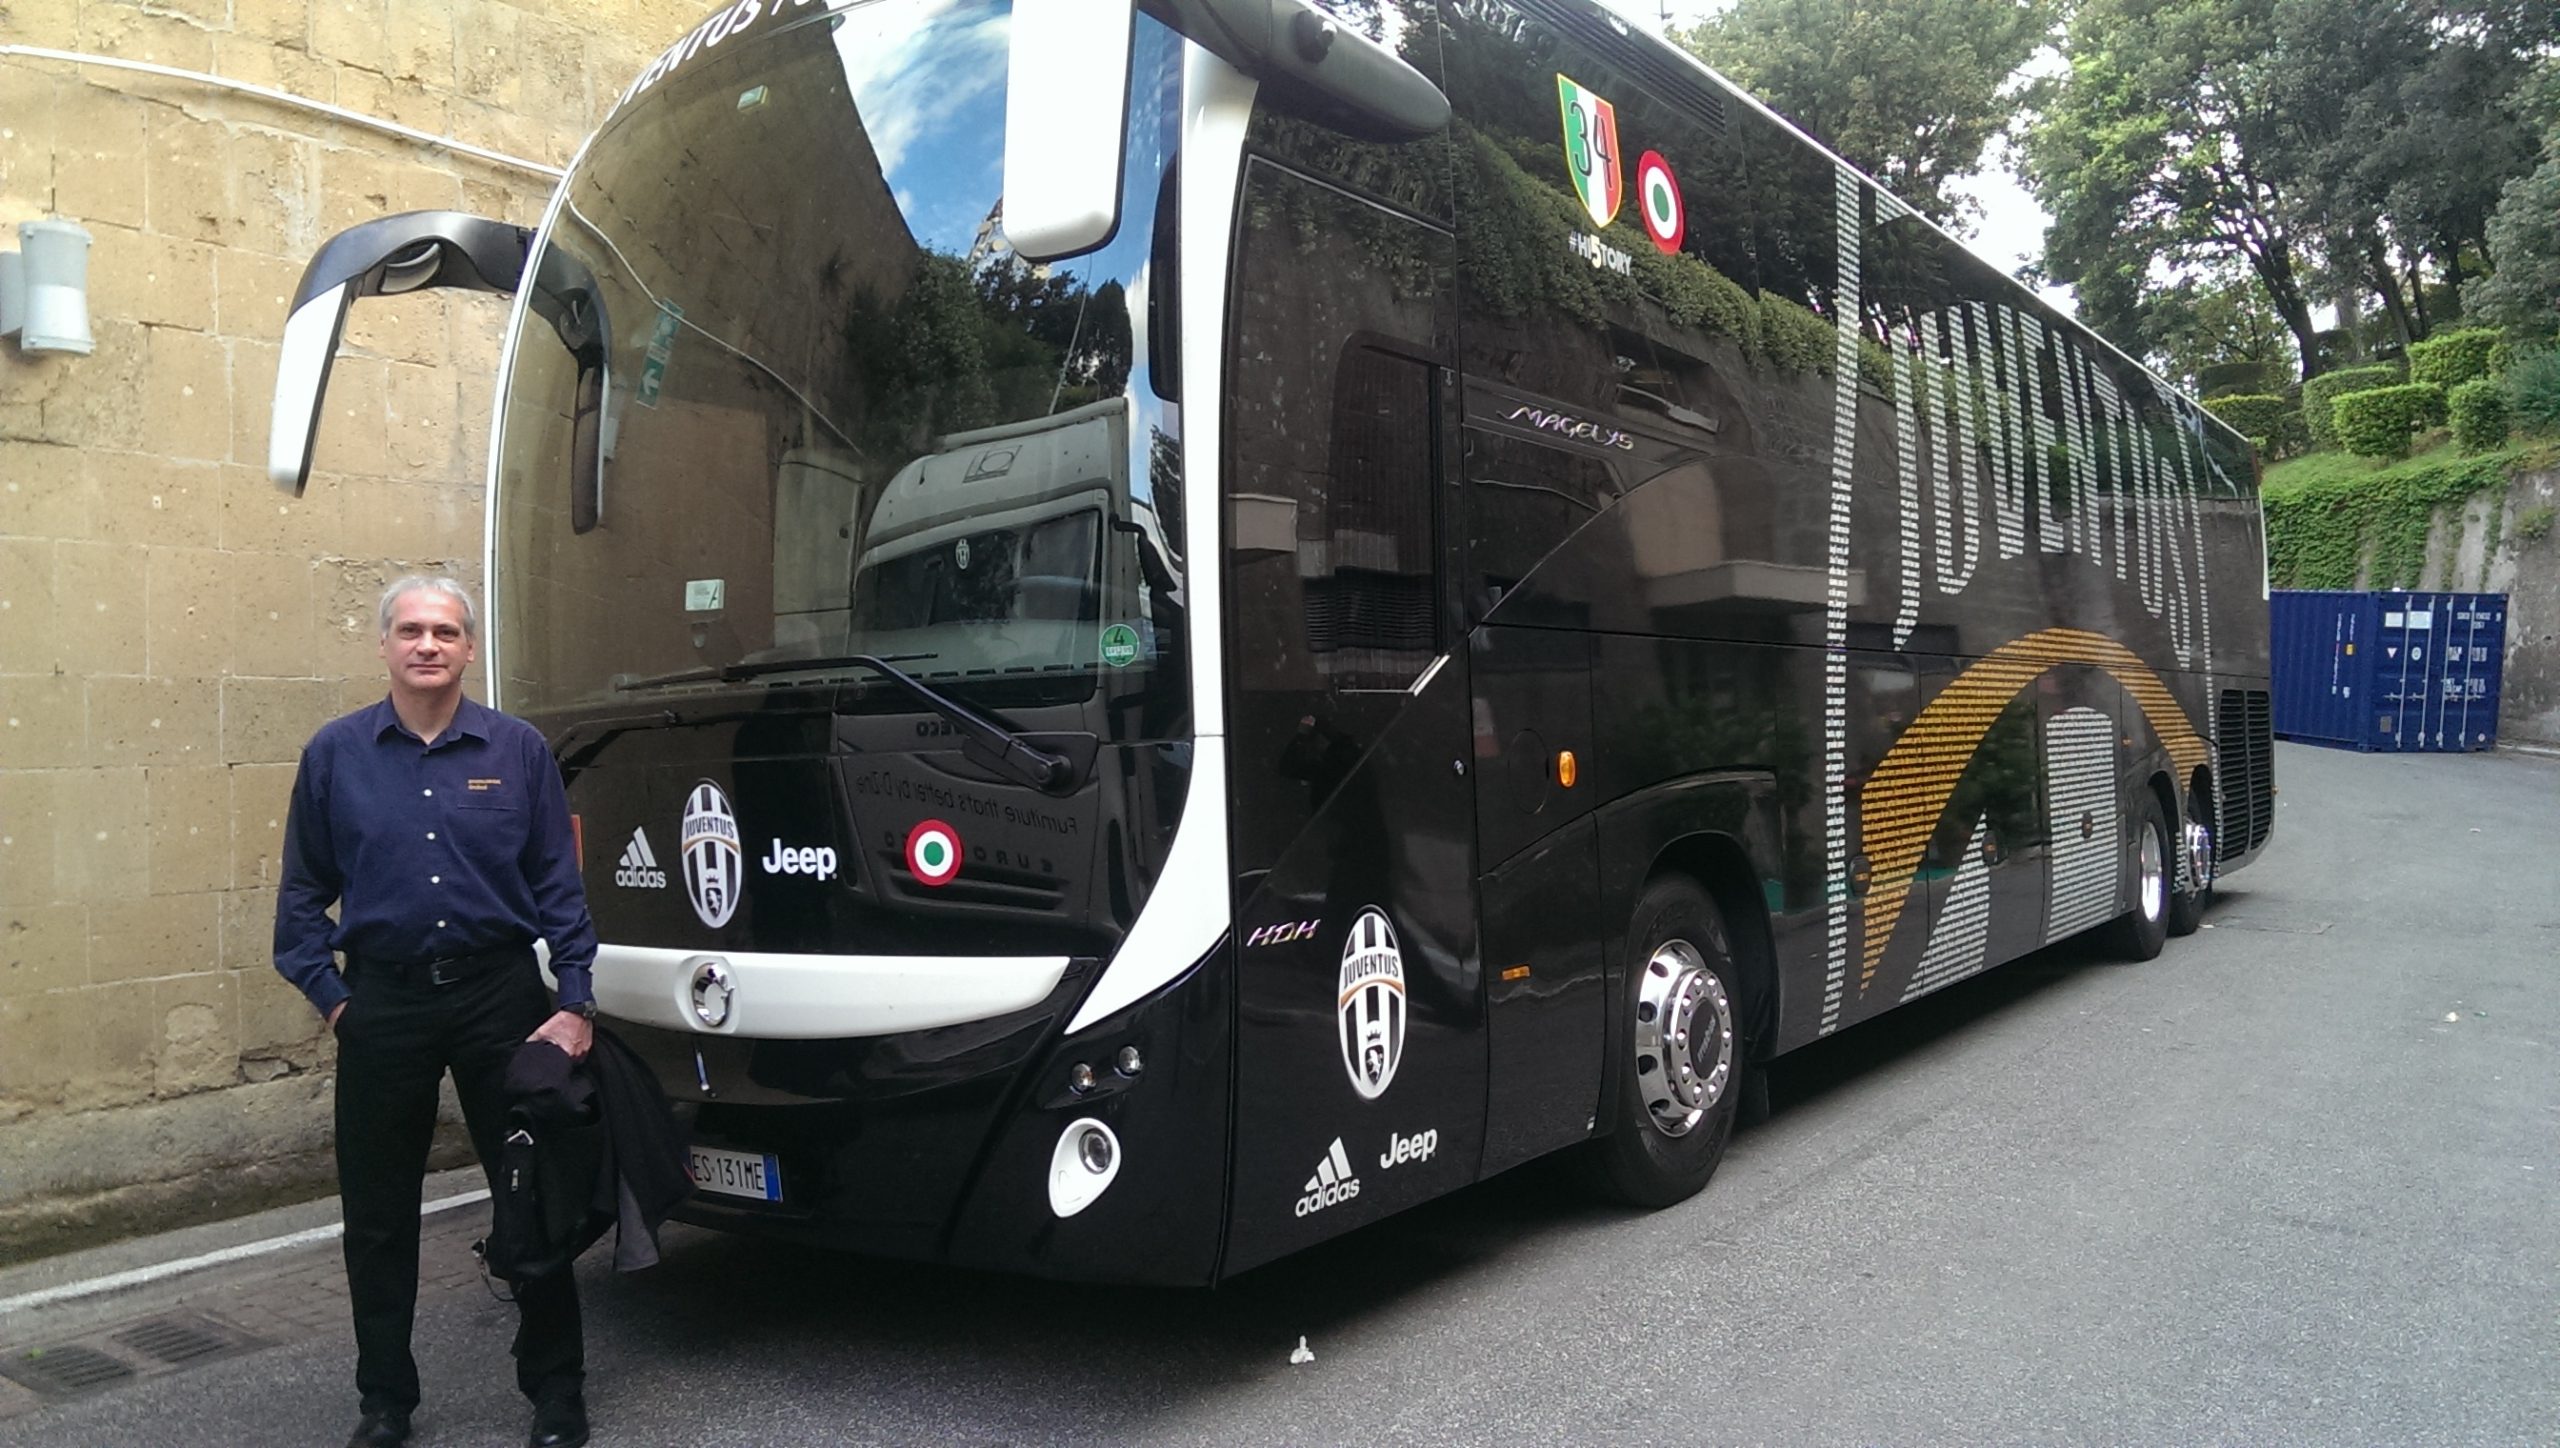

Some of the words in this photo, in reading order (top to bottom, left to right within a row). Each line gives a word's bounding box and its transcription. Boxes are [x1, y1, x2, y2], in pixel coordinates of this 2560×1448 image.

[1570, 101, 1613, 190] 34
[1568, 230, 1633, 277] #HI5TORY
[1496, 406, 1634, 450] MAGELYS
[1891, 299, 2191, 669] JUVENTUS
[1113, 628, 1125, 646] 4
[684, 816, 735, 840] JUVENTUS
[615, 865, 667, 889] adidas
[762, 837, 837, 882] Jeep
[1246, 918, 1321, 947] HDH
[1343, 953, 1399, 989] JUVENTUS
[1379, 1128, 1438, 1169] Jeep
[1295, 1178, 1360, 1218] adidas
